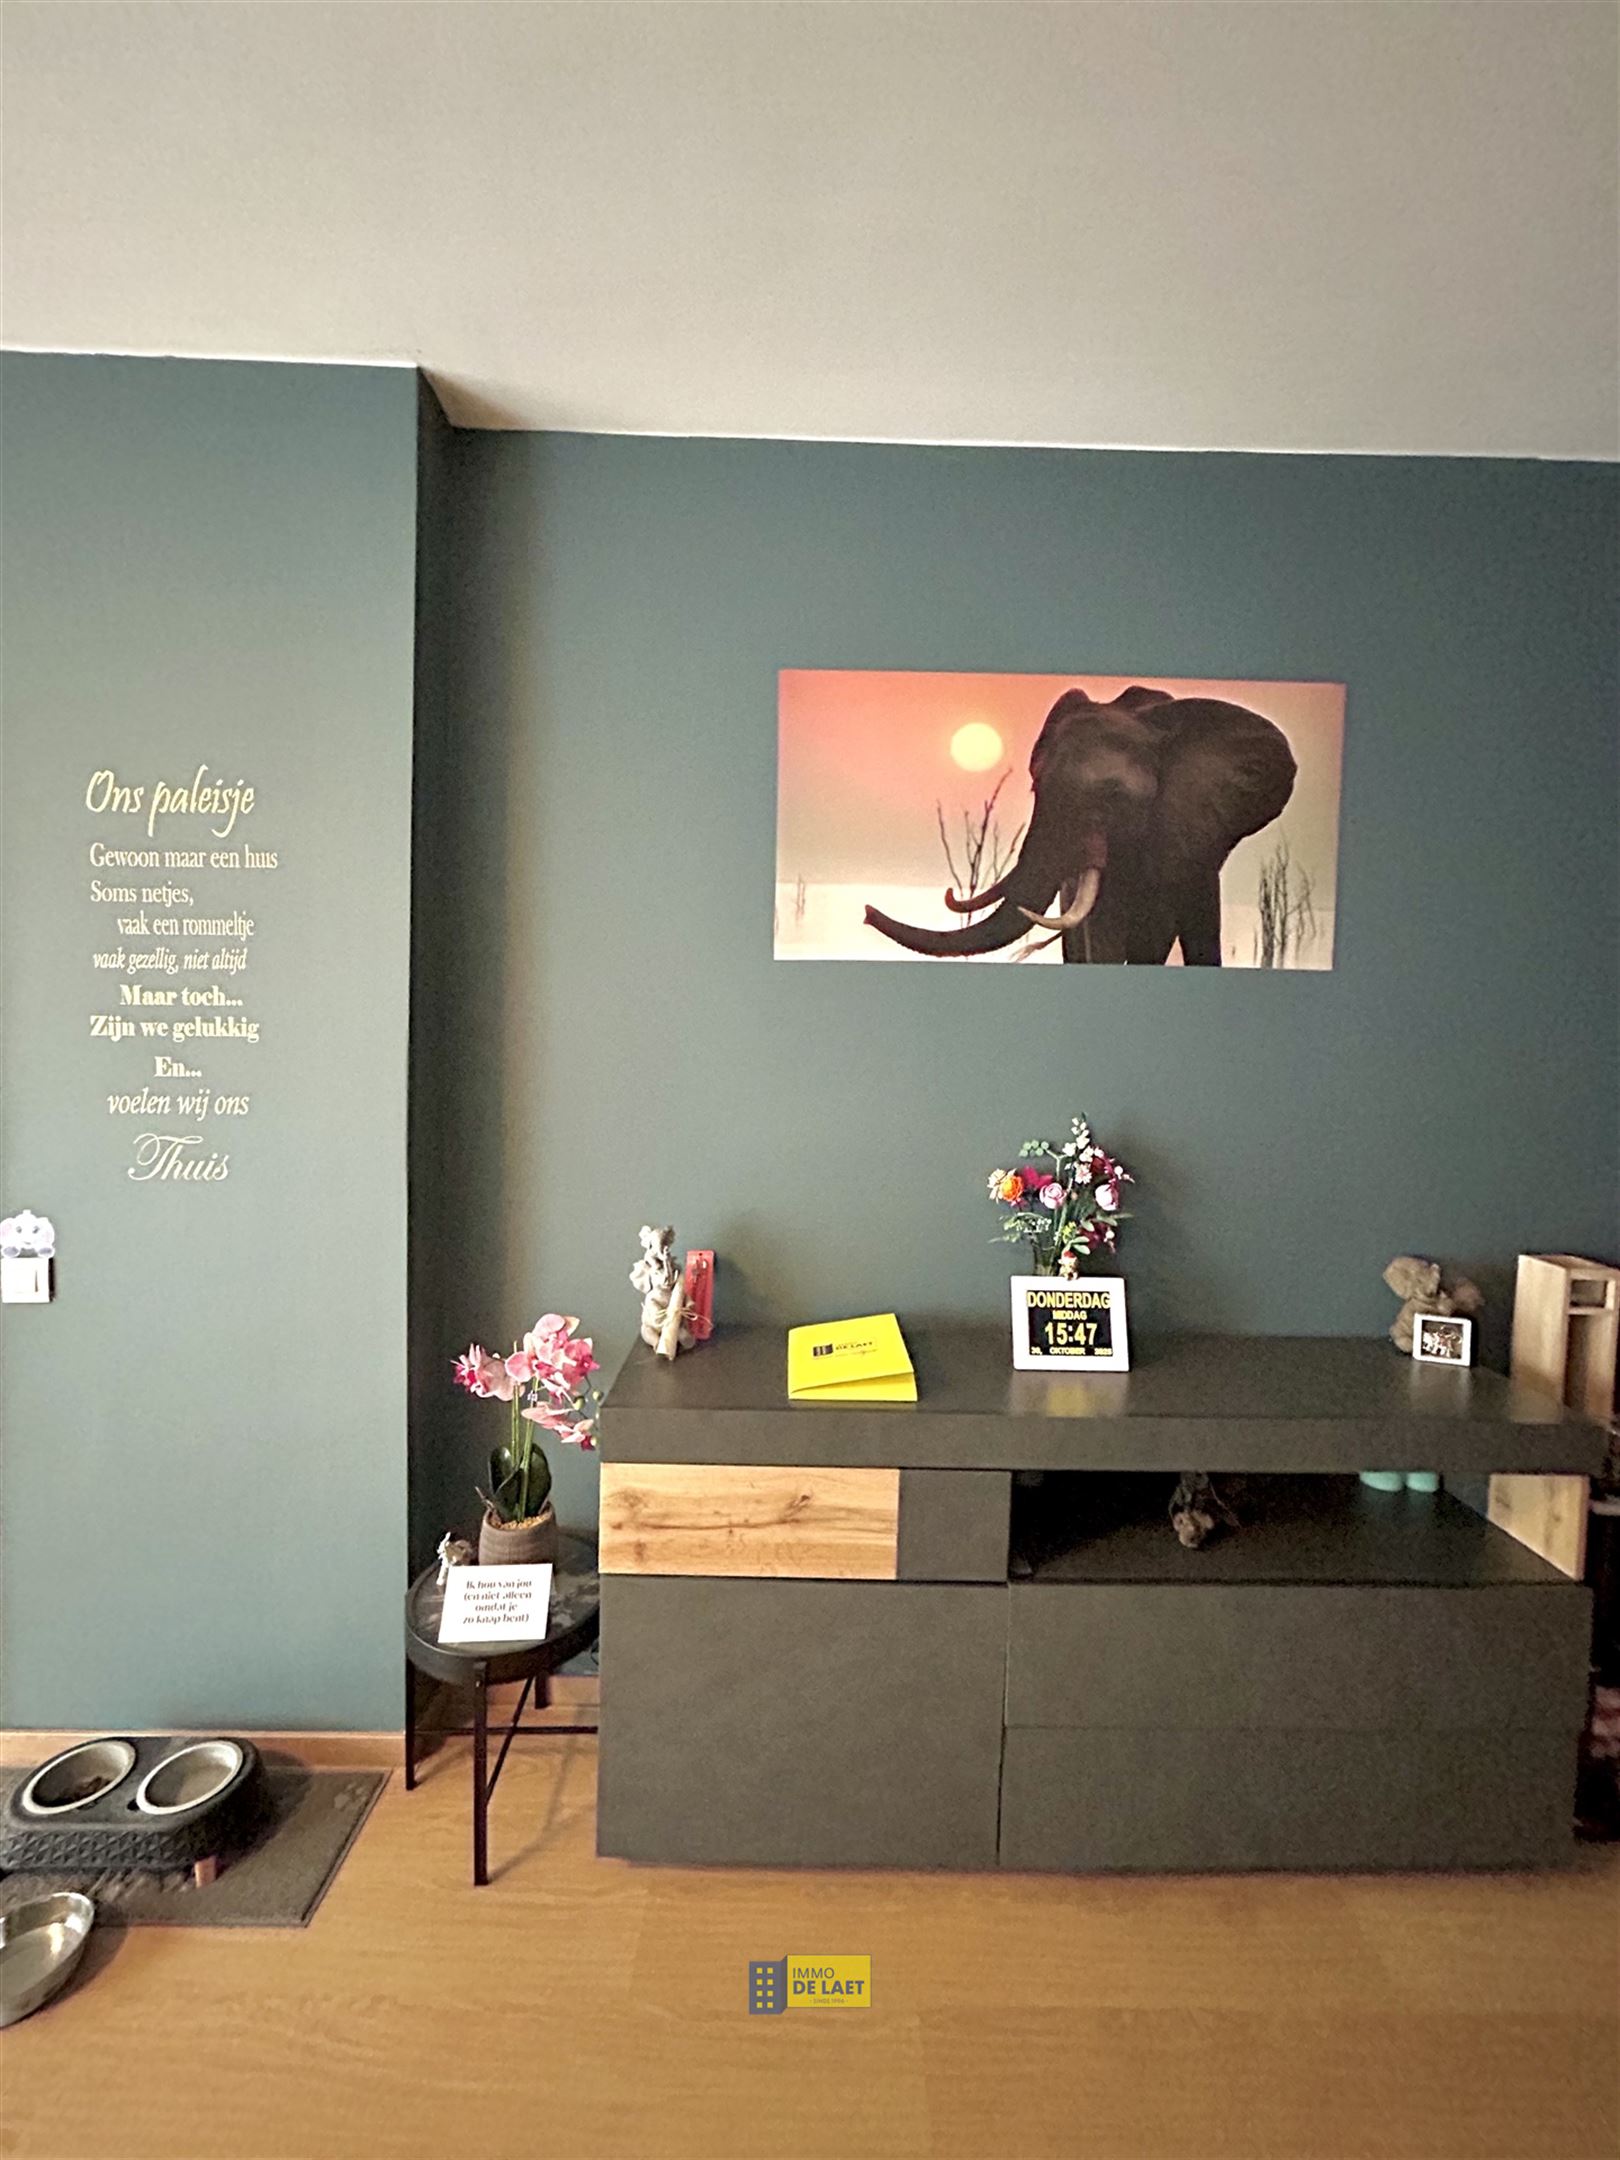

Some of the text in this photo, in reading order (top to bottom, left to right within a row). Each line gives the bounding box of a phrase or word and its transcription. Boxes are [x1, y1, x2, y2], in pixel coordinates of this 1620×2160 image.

[85, 764, 255, 838] Ons paleisje
[89, 841, 278, 869] Gewoon maar een huis
[90, 880, 194, 908] Soms netjes,
[117, 909, 255, 941] vaak een rommeltje
[93, 946, 248, 976] vaak gezellig, niet altijd
[119, 984, 243, 1007] Maar toch...
[90, 1014, 260, 1043] Zijn we gelukkig
[154, 1056, 202, 1078] En...
[107, 1086, 250, 1121] voelen wij ons
[127, 1132, 230, 1181] Thuis
[1026, 1291, 1111, 1309] DONDERDAG
[1052, 1310, 1088, 1320] MIDDAG
[1044, 1321, 1098, 1346] 15:47
[477, 1580, 496, 1589] hou
[481, 1591, 500, 1600] niet
